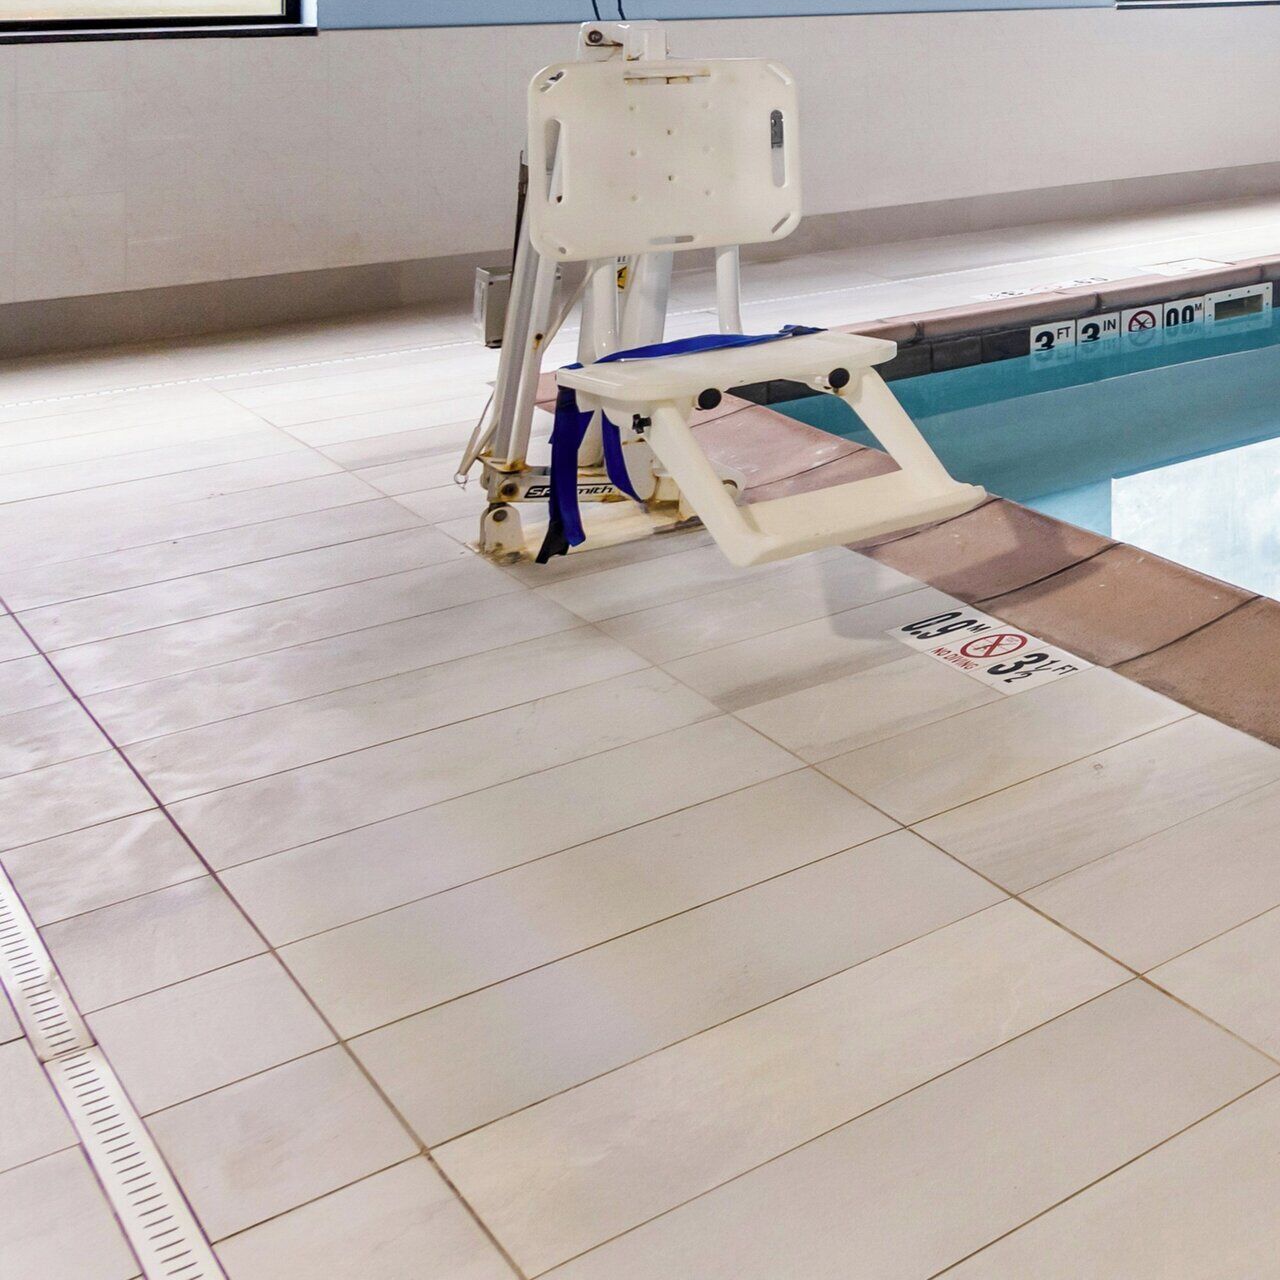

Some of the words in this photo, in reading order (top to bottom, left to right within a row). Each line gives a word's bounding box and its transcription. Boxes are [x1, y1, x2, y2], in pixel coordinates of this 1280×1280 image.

[1195, 302, 1202, 311] M
[1057, 326, 1071, 339] FT
[1103, 319, 1116, 331] IN
[578, 485, 613, 494] mith
[966, 623, 992, 633] M
[931, 646, 951, 657] NO
[943, 653, 979, 670] DIVING
[1053, 664, 1079, 675] FT
